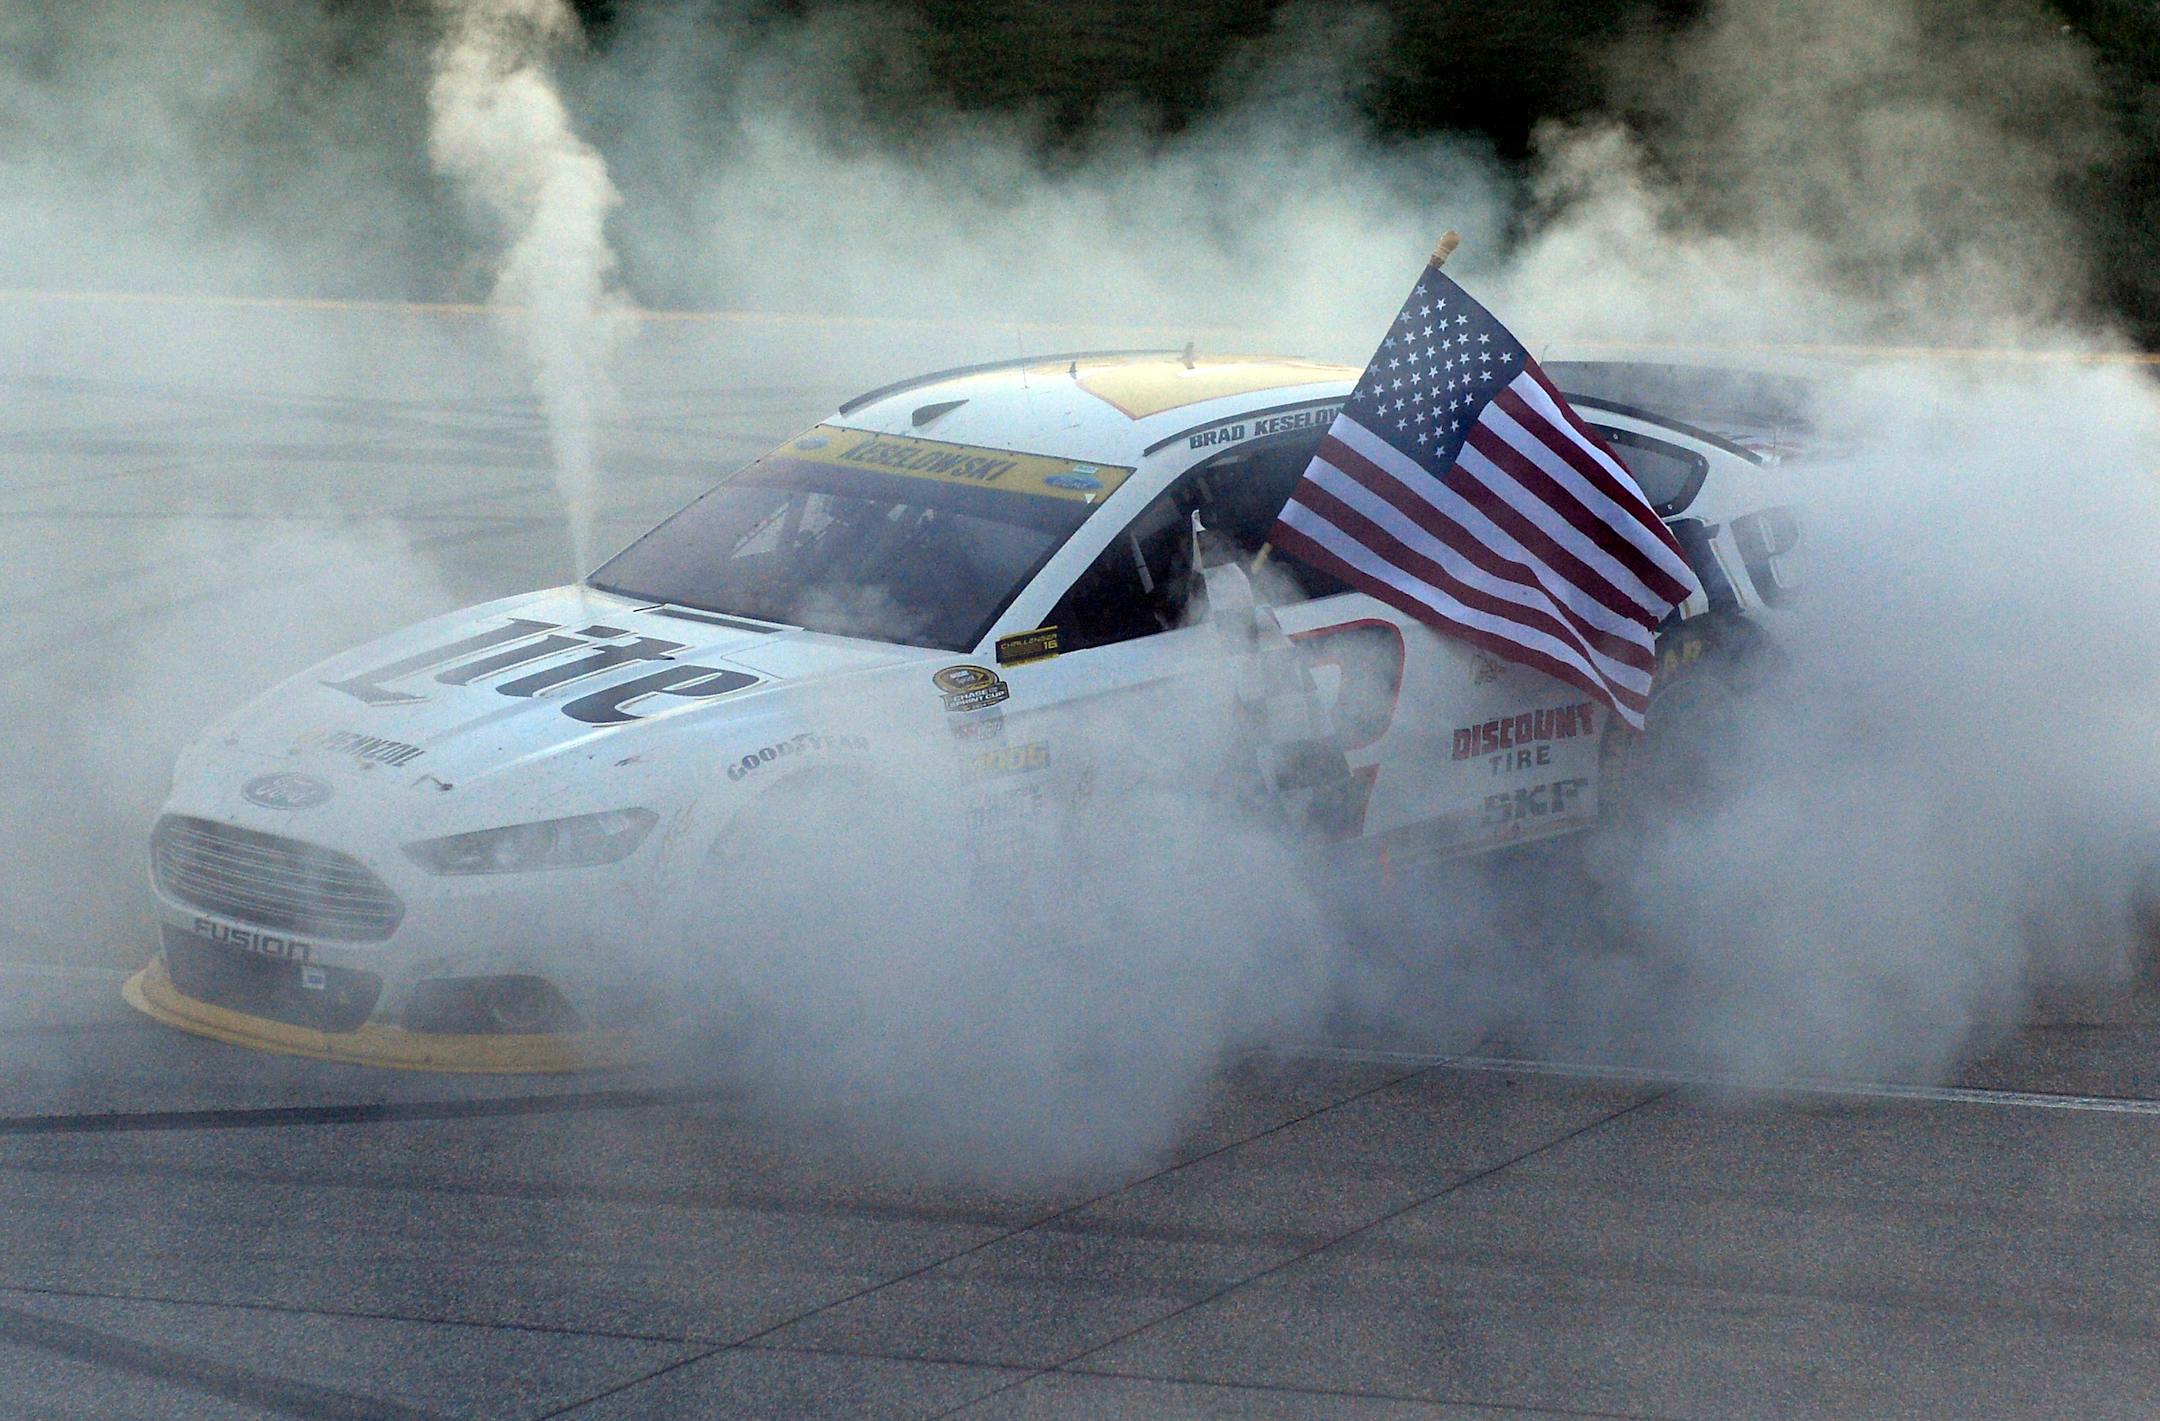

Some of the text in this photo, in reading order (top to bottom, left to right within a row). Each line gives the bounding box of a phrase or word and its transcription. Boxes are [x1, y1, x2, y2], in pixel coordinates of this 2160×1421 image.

[1189, 424, 1246, 449] BRAD
[839, 440, 1018, 482] KESELOWSKI
[1043, 640, 1058, 650] 16
[318, 617, 762, 727] Lite
[984, 690, 1005, 701] CUP
[1452, 702, 1593, 761] DISCOUNT
[1489, 744, 1551, 776] TIRE
[1483, 778, 1588, 822] SKF
